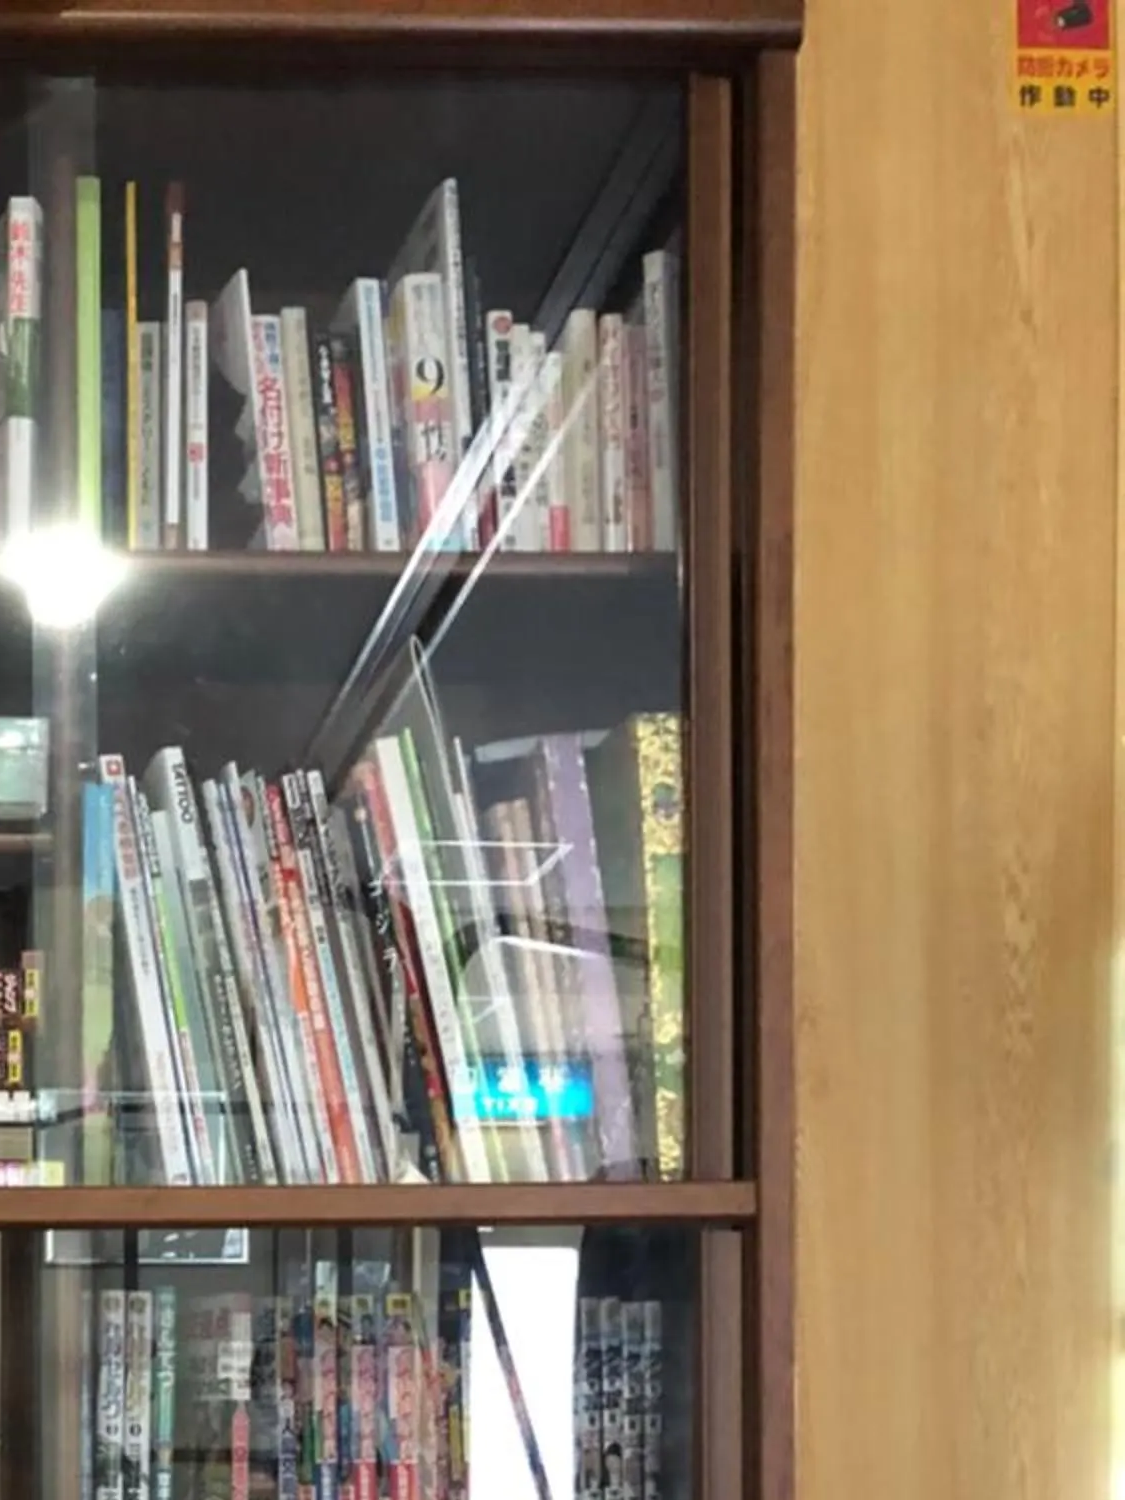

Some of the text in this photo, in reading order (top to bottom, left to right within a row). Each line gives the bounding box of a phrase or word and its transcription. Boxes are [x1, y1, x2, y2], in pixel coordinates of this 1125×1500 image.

[1019, 84, 1111, 109] 作動中
[415, 357, 446, 395] 9
